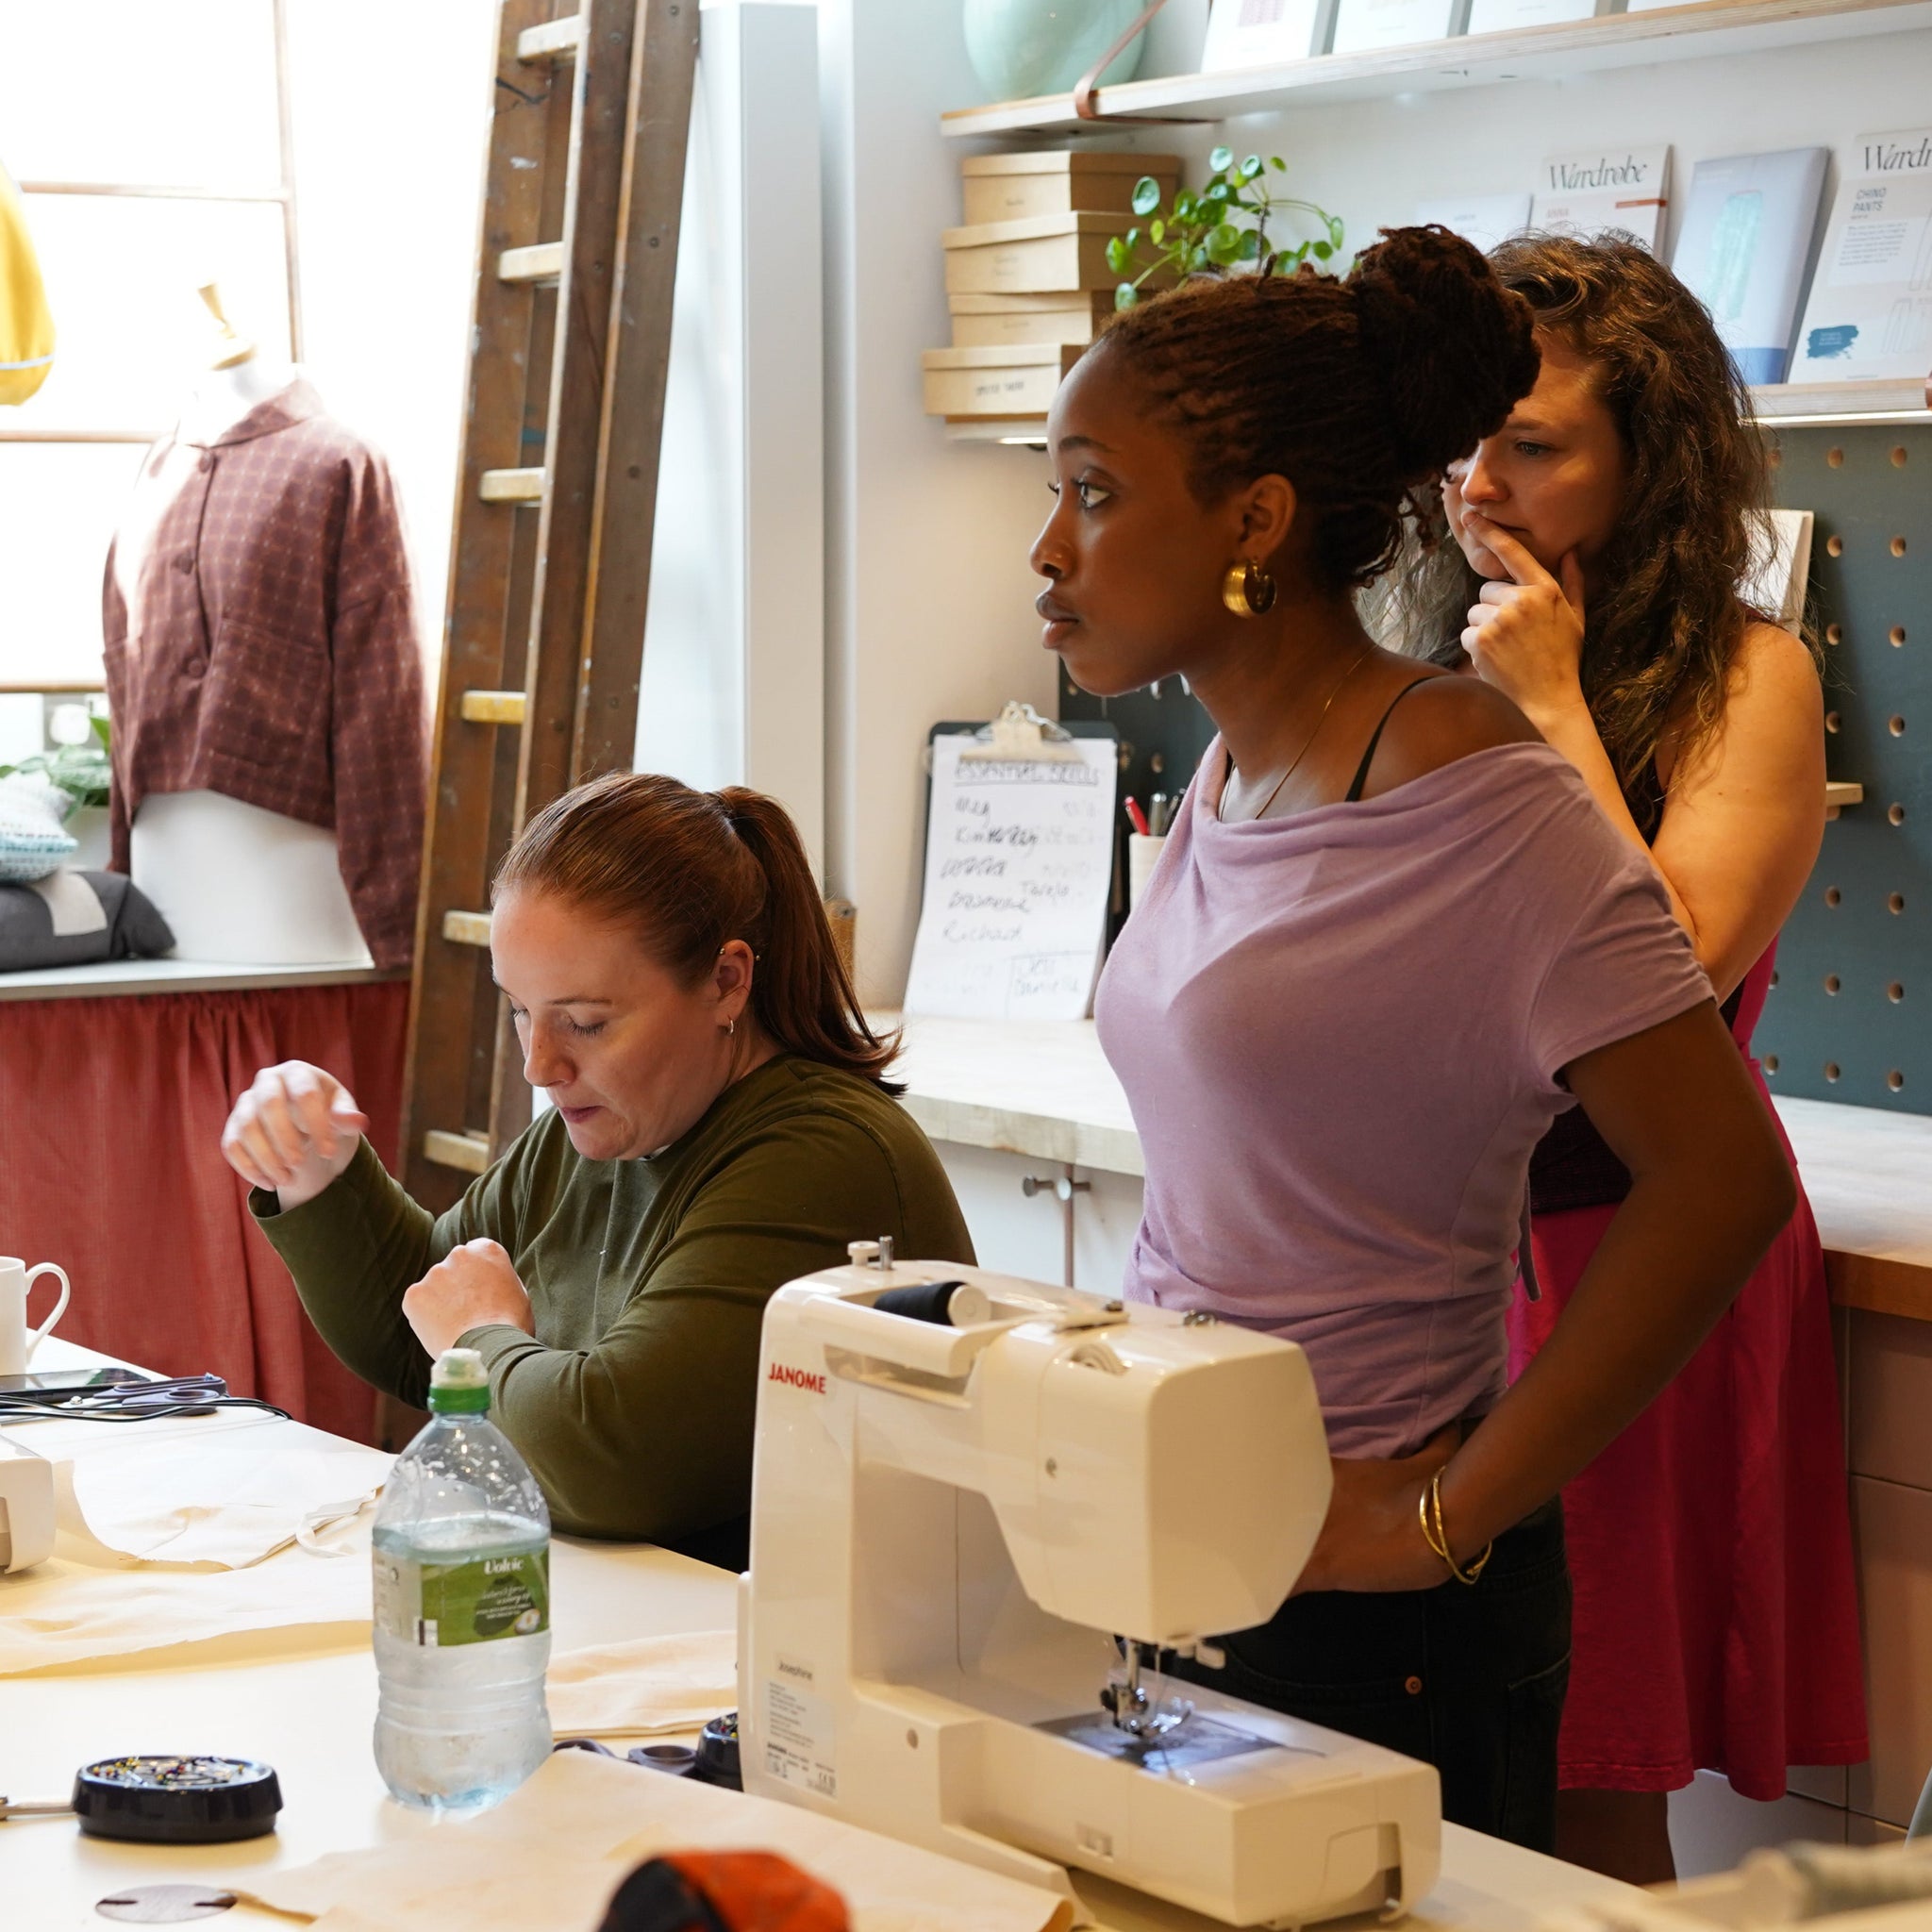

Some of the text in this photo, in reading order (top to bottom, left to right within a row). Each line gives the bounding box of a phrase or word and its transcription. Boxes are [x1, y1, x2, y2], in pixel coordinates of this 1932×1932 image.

[1550, 155, 1647, 190] Wardrobe
[1856, 187, 1887, 200] CHINO
[1852, 200, 1884, 212] PANTS
[768, 1362, 826, 1395] JANOME
